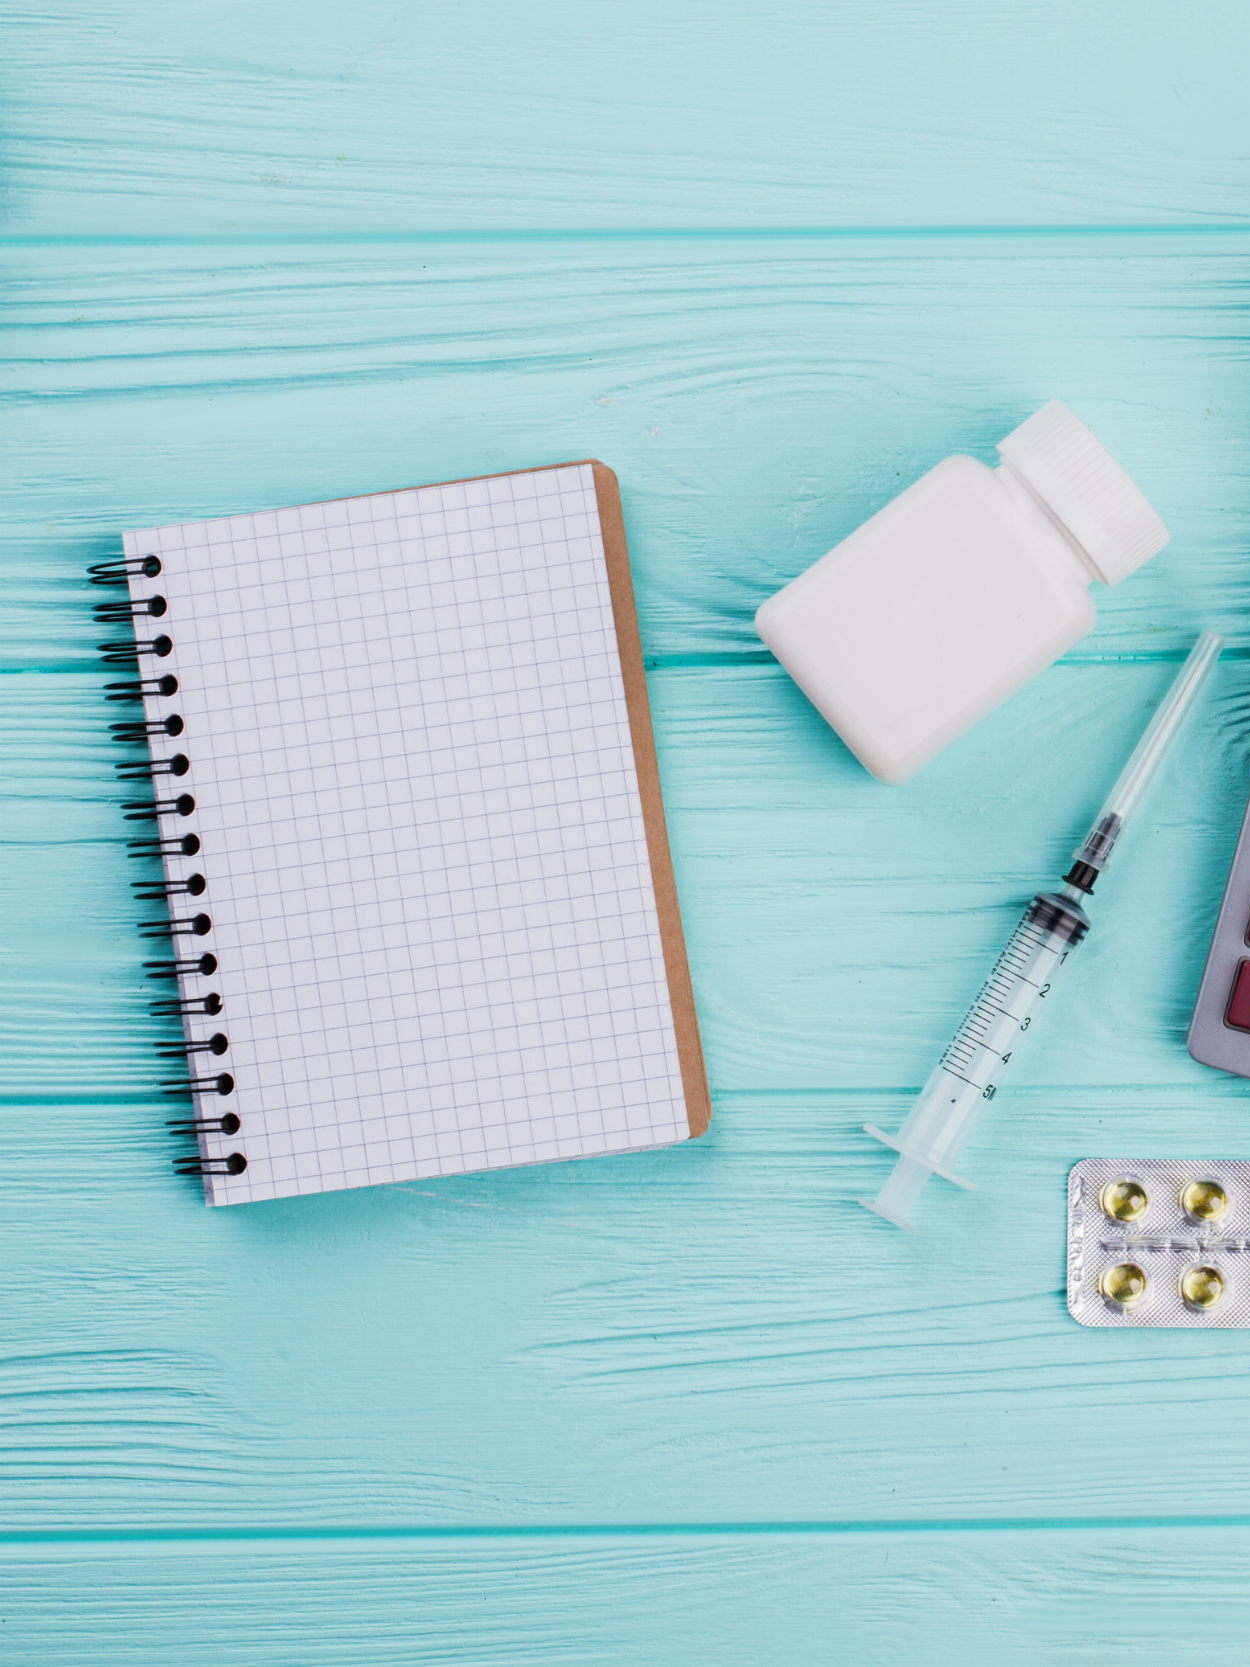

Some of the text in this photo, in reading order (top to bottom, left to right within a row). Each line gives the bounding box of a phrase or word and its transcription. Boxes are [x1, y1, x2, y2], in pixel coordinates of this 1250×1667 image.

[1060, 951, 1069, 965] 1
[1038, 983, 1051, 998] 2
[1020, 1016, 1032, 1031] 3
[1001, 1052, 1012, 1065] 4
